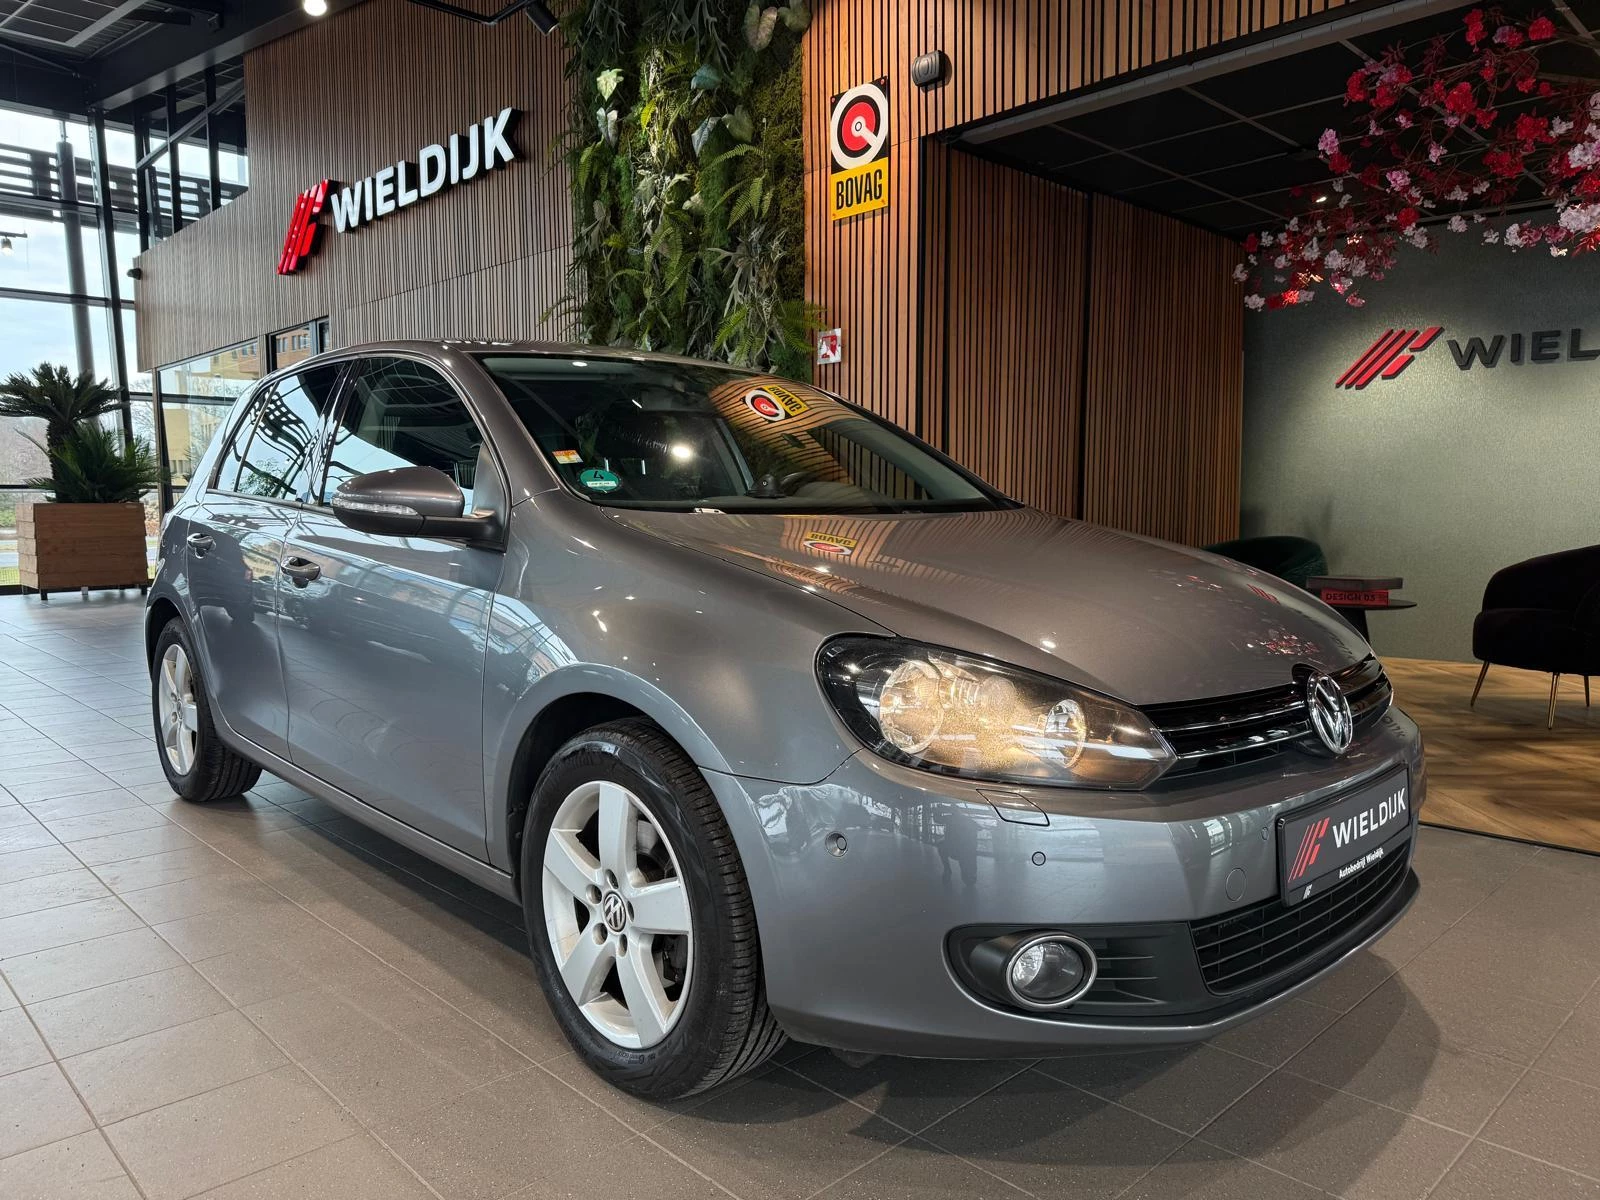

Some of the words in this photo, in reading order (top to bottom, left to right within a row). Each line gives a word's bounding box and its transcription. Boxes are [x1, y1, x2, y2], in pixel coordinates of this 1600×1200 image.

[330, 106, 516, 234] WIELDIJK
[836, 168, 883, 211] BOVAG
[1447, 328, 1600, 371] WIEL
[1326, 592, 1361, 601] DESIGN
[1332, 787, 1407, 849] WIELDIJK
